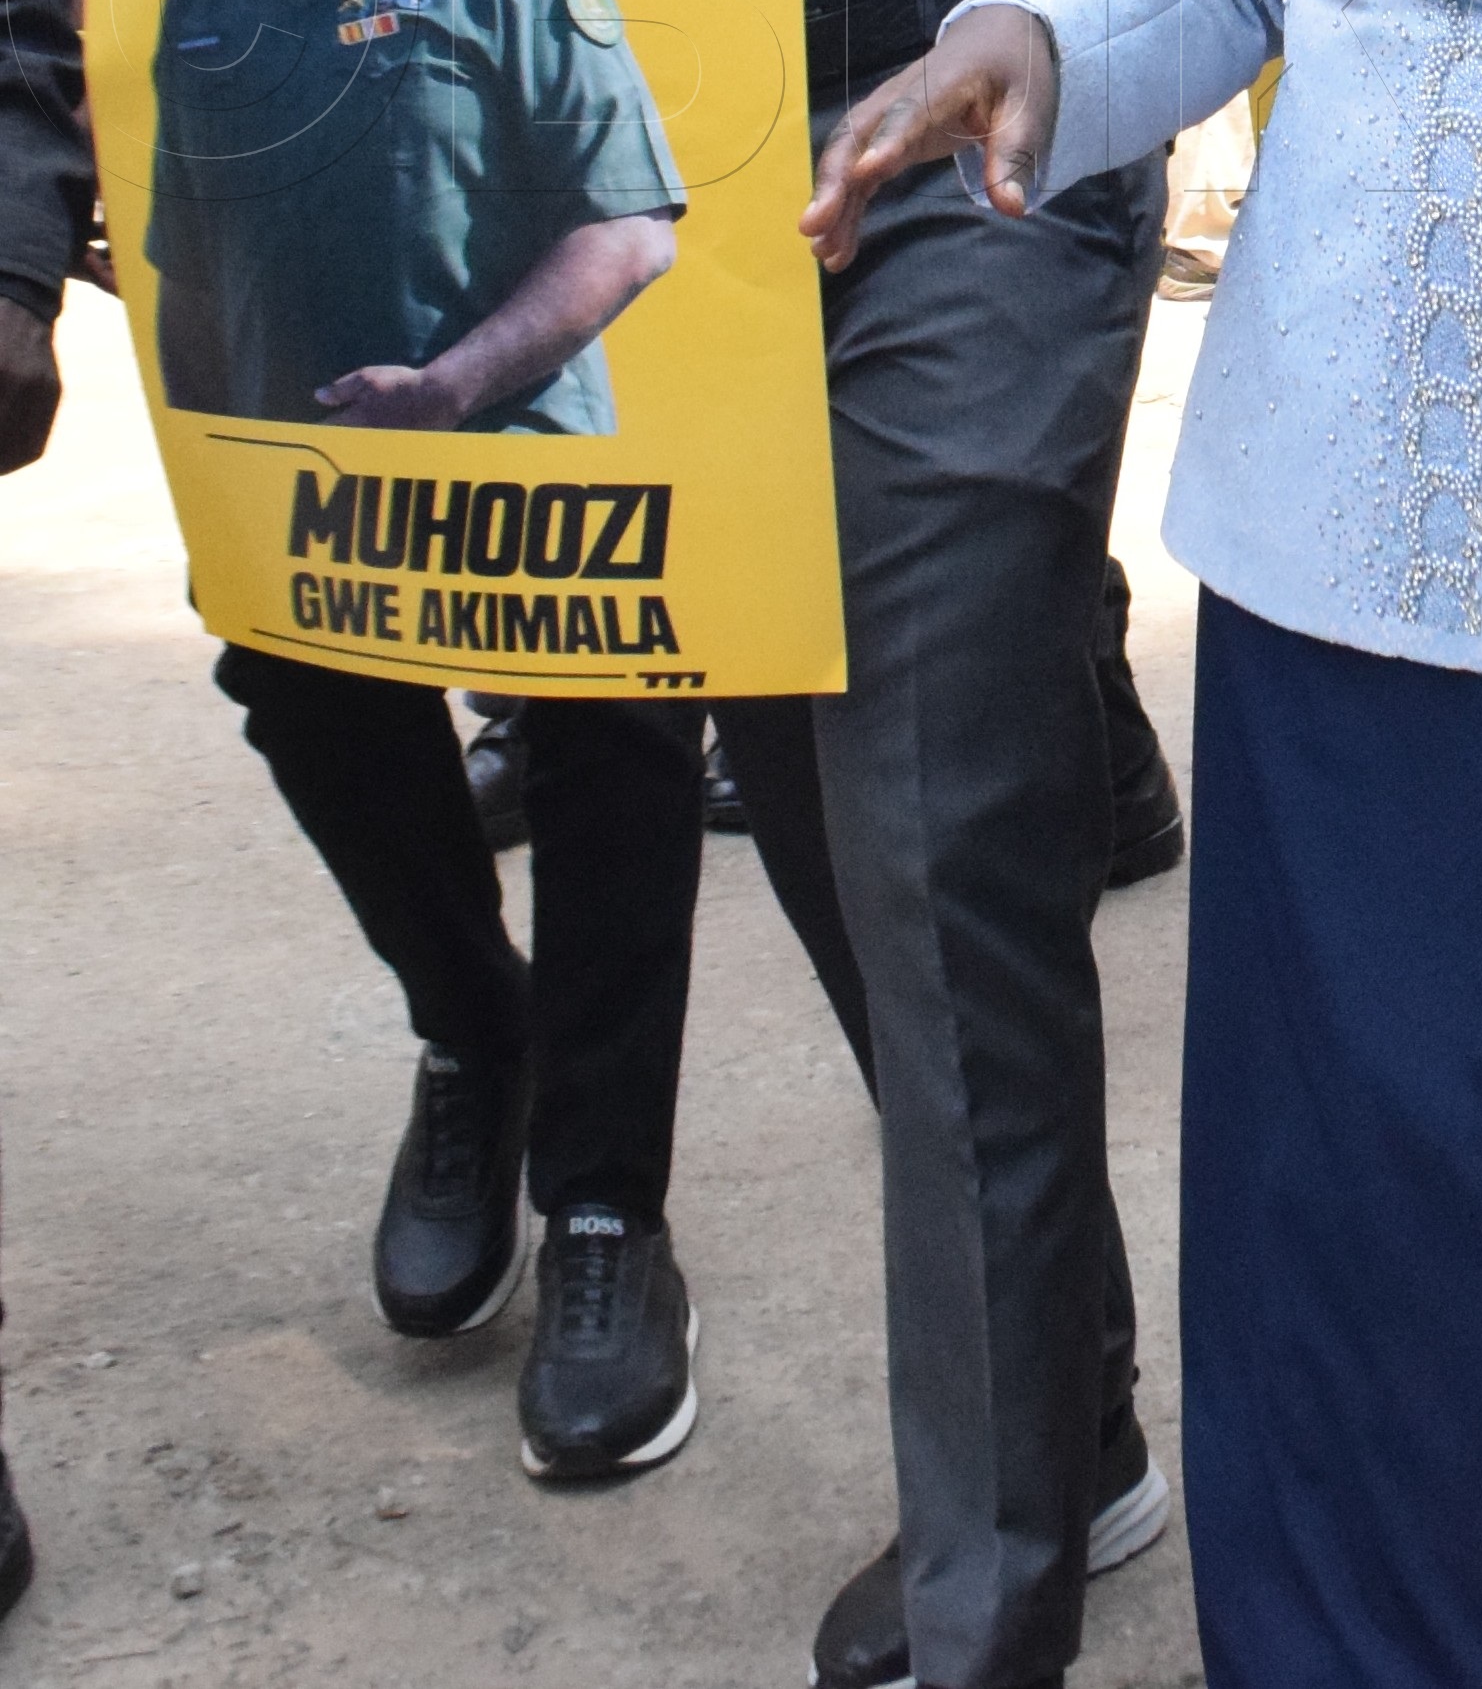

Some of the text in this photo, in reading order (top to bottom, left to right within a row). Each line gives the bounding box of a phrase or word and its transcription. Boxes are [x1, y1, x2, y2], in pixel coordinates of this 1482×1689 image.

[288, 469, 673, 580] MUHOOZI
[290, 571, 681, 655] GWE AKIMALA
[569, 1215, 625, 1236] BOSS
